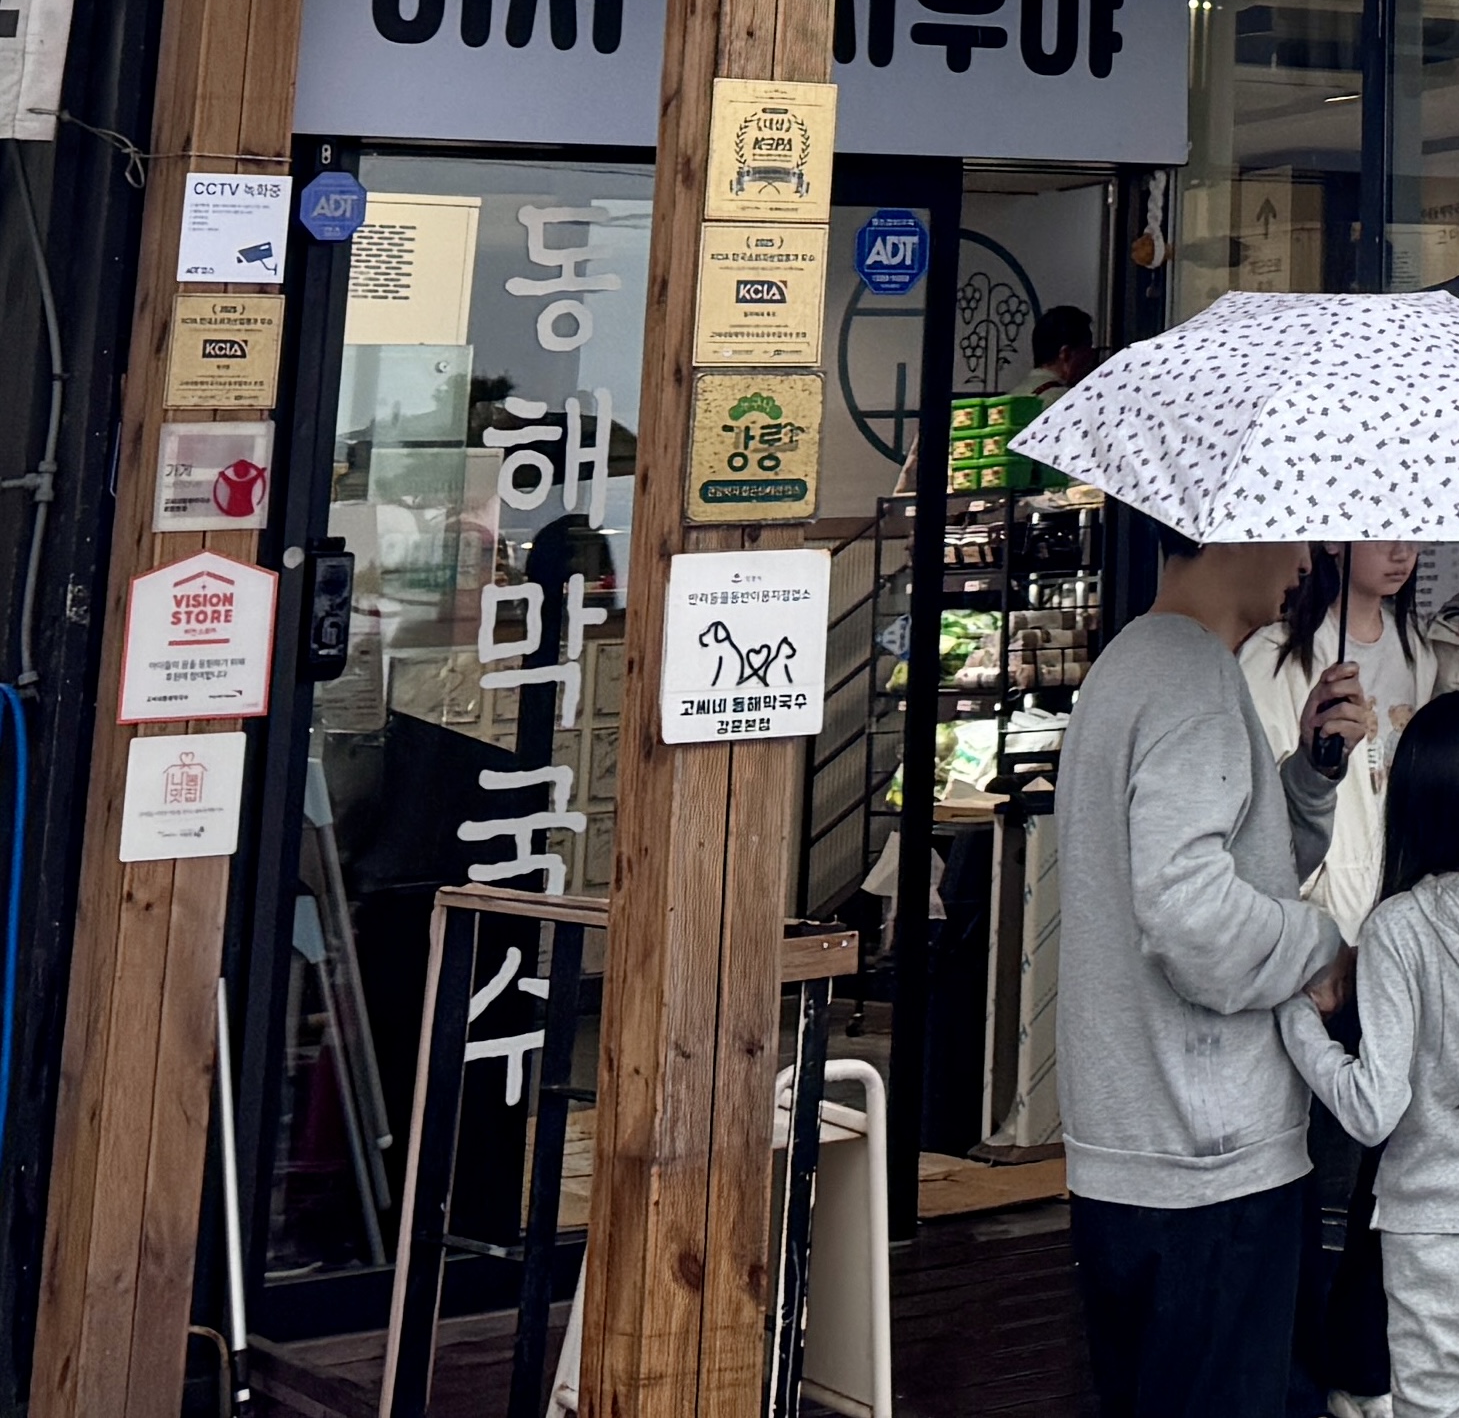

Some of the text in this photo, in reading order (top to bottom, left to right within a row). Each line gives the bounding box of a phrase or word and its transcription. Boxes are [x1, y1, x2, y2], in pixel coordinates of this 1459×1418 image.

[194, 182, 239, 196] CCTV
[310, 194, 359, 218] ADT
[866, 235, 919, 266] ADT
[739, 284, 781, 300] KCIA
[205, 342, 241, 357] KCIA
[173, 593, 234, 609] VISION
[171, 609, 233, 626] STORE
[462, 203, 620, 1106] 동해막국수
[680, 693, 808, 716] 고씨네 동해막국수
